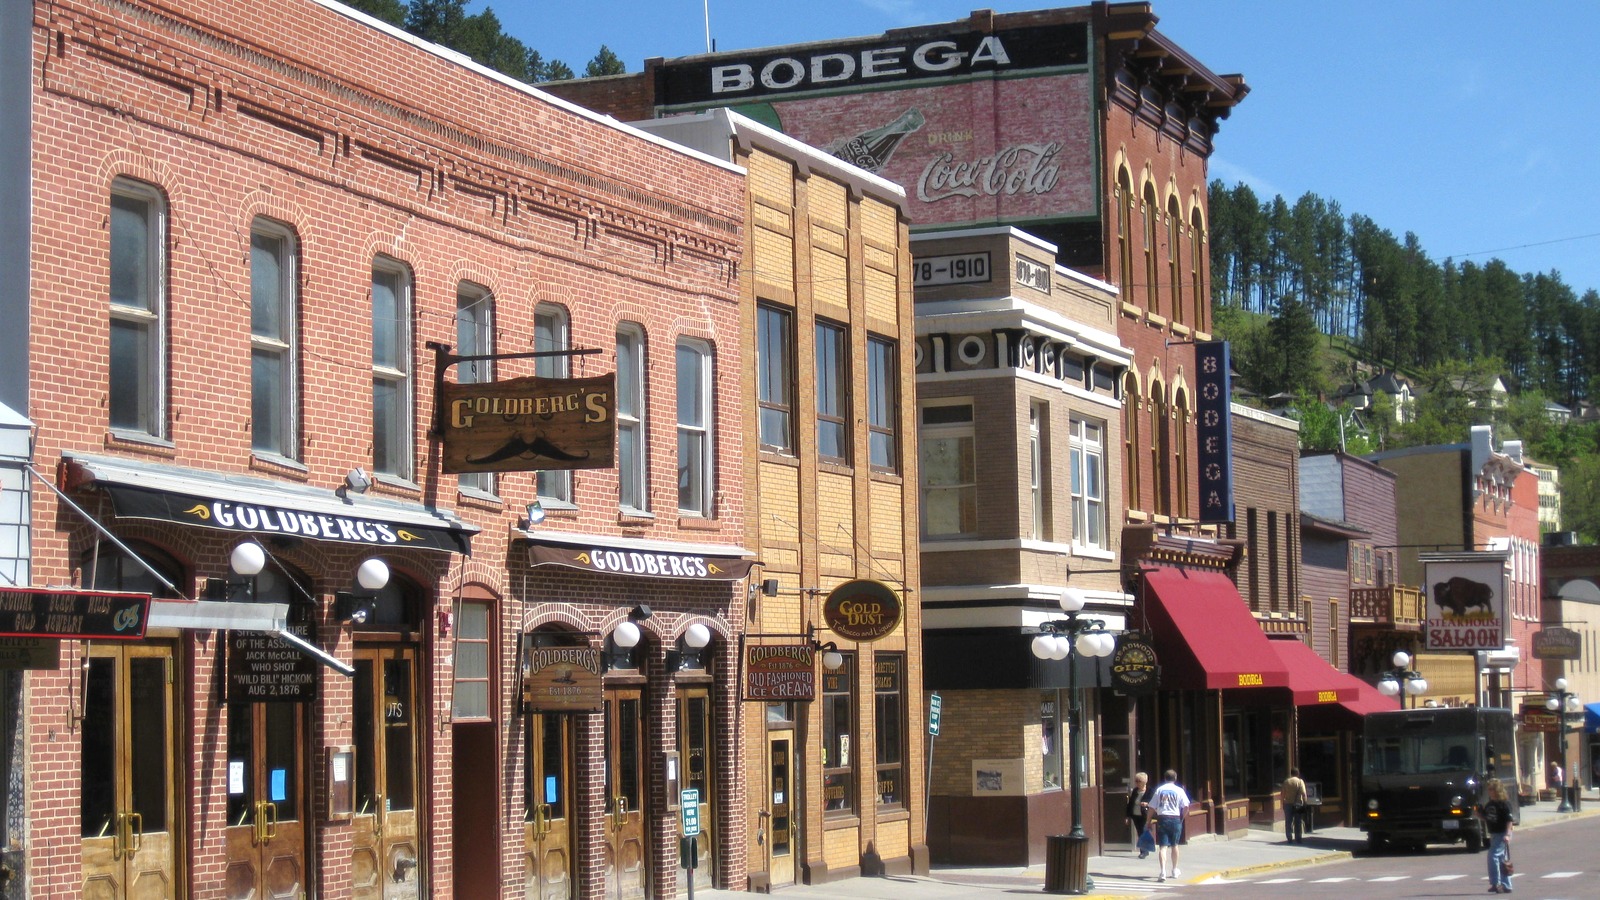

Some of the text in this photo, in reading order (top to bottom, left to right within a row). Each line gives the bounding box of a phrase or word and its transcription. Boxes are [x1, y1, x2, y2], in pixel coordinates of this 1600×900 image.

[711, 36, 1011, 94] BODEGA
[928, 130, 974, 146] DRINK
[451, 387, 608, 430] GOLDBERG'S
[1203, 356, 1222, 508] BODEGA
[590, 549, 708, 578] GOLDBERG'S
[88, 596, 112, 615] HILLS
[839, 600, 881, 616] GOLD
[45, 615, 84, 633] JEWELRY
[848, 612, 885, 626] DUST
[1428, 618, 1501, 627] STEAKHOUSE
[832, 619, 894, 637] Tobacco and Liquor
[236, 639, 247, 649] OF
[250, 639, 266, 649] THE
[1430, 628, 1500, 647] SALOON
[245, 651, 302, 660] JACK McCALL
[1115, 642, 1154, 661] DEADWOOD
[251, 662, 296, 672] WHO SHOT
[779, 662, 794, 670] 1876
[1114, 664, 1154, 673] GIFT
[234, 673, 313, 685] "WILD BILL" HICKOK
[748, 671, 812, 687] OLD FASHIONED
[1238, 673, 1263, 686] BODEGA
[248, 685, 266, 695] AUG
[280, 685, 300, 695] 1876
[563, 686, 582, 696] 1876
[749, 681, 813, 697] ICE CREAM
[1318, 690, 1337, 703] BODEGA
[686, 818, 696, 826] $1.00
